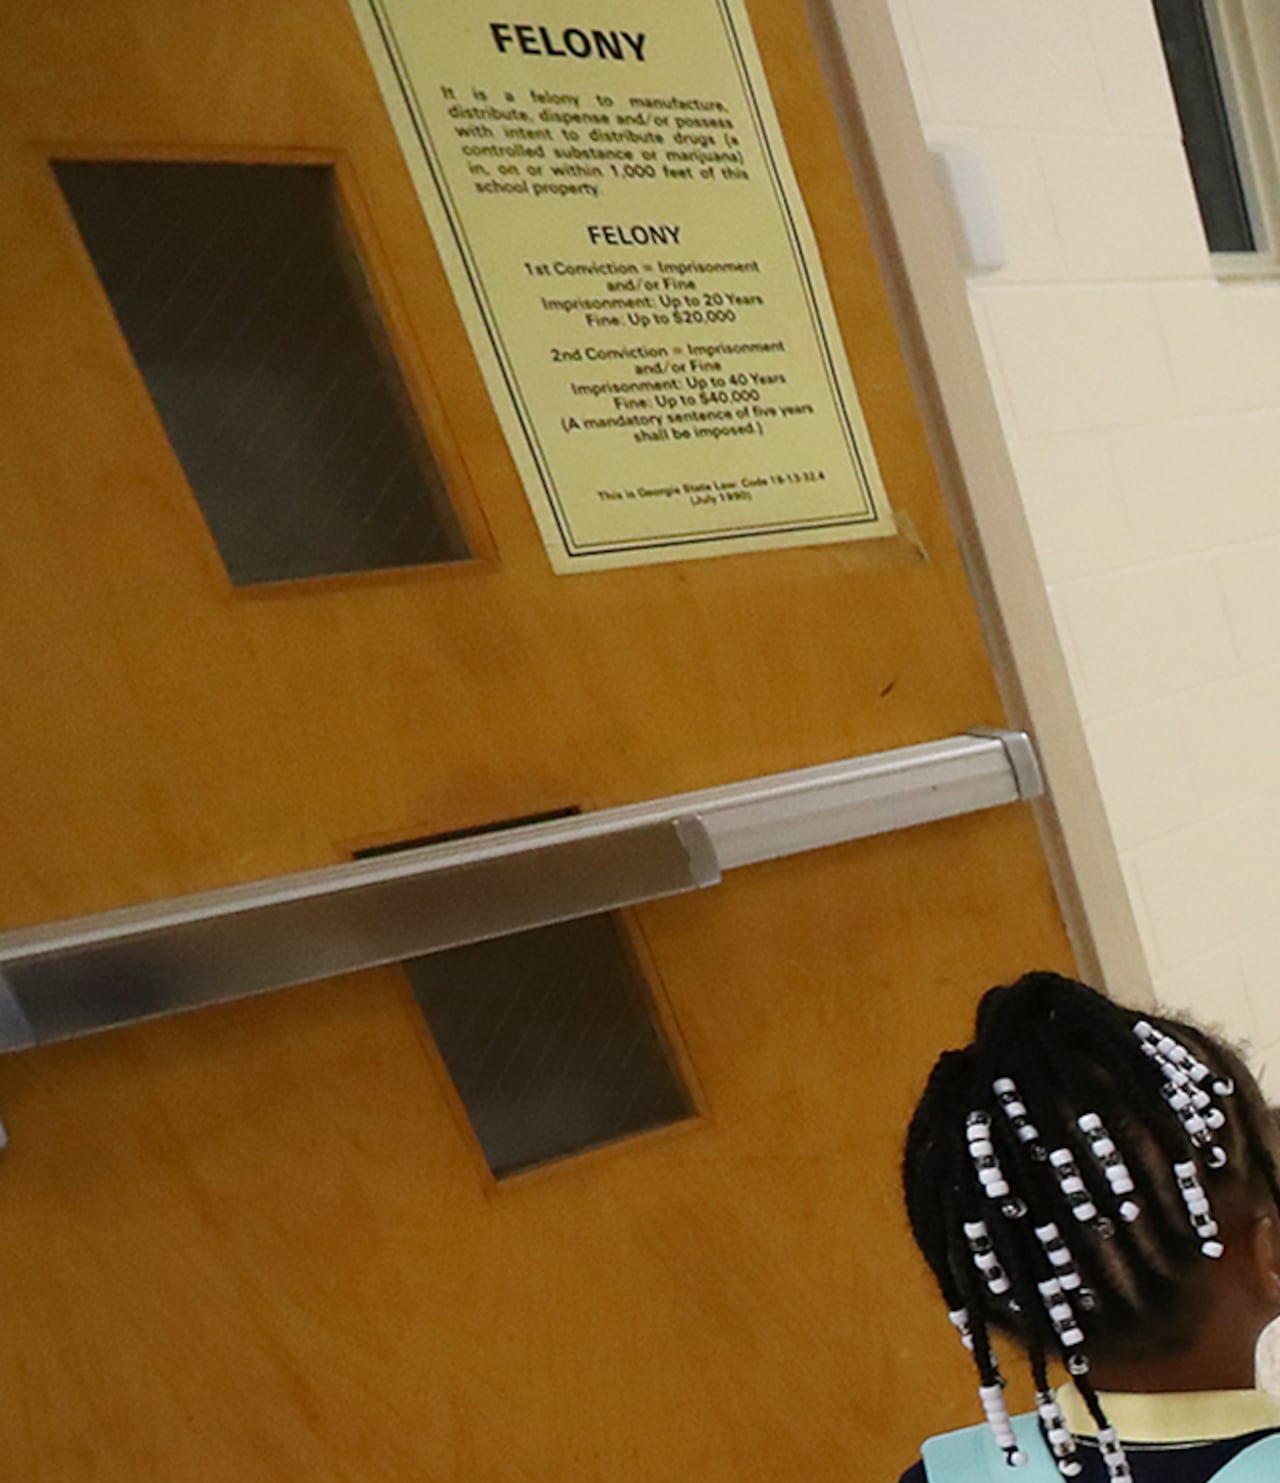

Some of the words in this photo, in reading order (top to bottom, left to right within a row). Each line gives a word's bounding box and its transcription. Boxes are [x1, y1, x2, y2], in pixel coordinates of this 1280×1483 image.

[489, 22, 646, 62] FELONY
[440, 85, 456, 101] It
[472, 87, 488, 102] is
[504, 91, 515, 103] a
[529, 89, 580, 109] felony
[595, 94, 614, 108] to
[538, 108, 610, 126] dispense
[616, 112, 669, 127] and/or
[674, 116, 734, 130] possess
[453, 124, 494, 139] with
[502, 125, 554, 141] intent
[561, 128, 580, 142] to
[588, 128, 664, 144] distribute
[672, 131, 716, 148] drugs
[724, 133, 739, 149] (a
[461, 143, 545, 159] controlled
[552, 146, 634, 161] substance
[641, 150, 657, 161] or
[665, 149, 744, 166] marijuana)
[497, 164, 520, 176] on
[526, 165, 543, 177] or
[549, 162, 604, 178] within
[610, 164, 656, 180] 1,000
[662, 165, 694, 180] feet
[700, 166, 716, 180] of
[720, 167, 750, 181] this
[475, 179, 529, 194] school
[587, 225, 680, 246] FELONY
[524, 261, 552, 277] 1st
[553, 261, 640, 277] Conviction
[657, 259, 760, 275] Imprisonment
[606, 278, 659, 293] and/or
[662, 276, 696, 291] Fine
[540, 295, 655, 312] Imprisonment:
[658, 293, 681, 311] Up
[683, 295, 701, 308] to
[702, 292, 724, 307] 20
[724, 291, 764, 306] Years
[627, 311, 651, 328] Up
[652, 312, 670, 325] to
[671, 308, 737, 325] $20,000
[551, 347, 582, 362] 2nd
[584, 344, 668, 361] Conviction
[686, 340, 785, 357] Imprisonment
[634, 360, 688, 376] and/or
[689, 358, 722, 372] Fine
[570, 378, 683, 398] Imprisonment:
[685, 376, 708, 391] Up
[709, 376, 727, 389] to
[728, 372, 749, 387] 40
[749, 371, 787, 386] Years
[654, 393, 678, 410] Up
[679, 394, 697, 407] to
[698, 387, 761, 407] $40,000
[560, 416, 582, 435] (A
[583, 413, 664, 429] mandatory
[665, 408, 733, 424] sentence
[734, 405, 751, 420] of
[751, 404, 778, 418] five
[778, 402, 816, 419] years
[633, 427, 670, 443] shall
[670, 426, 692, 441] be
[597, 488, 623, 502] This
[637, 485, 681, 499] Georgia
[741, 477, 769, 489] Code
[688, 493, 718, 508] (July
